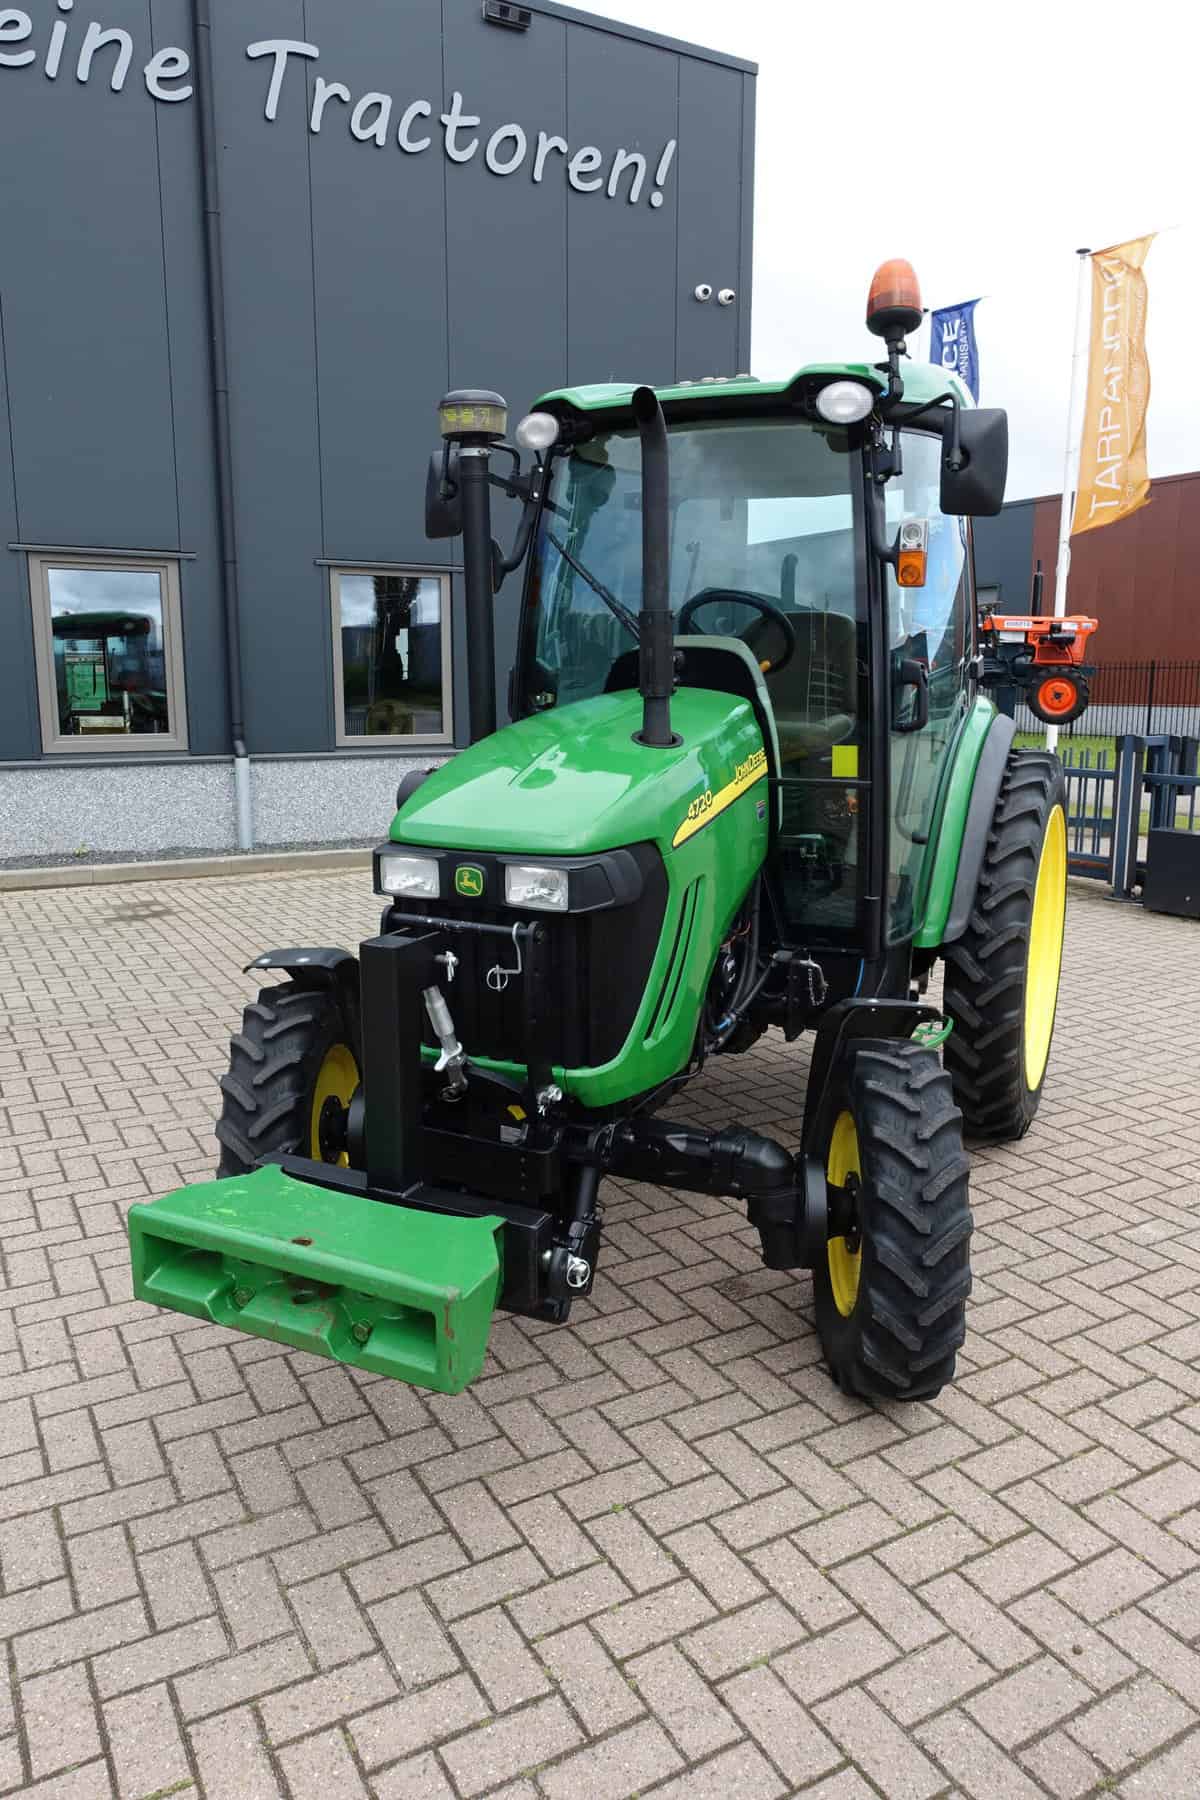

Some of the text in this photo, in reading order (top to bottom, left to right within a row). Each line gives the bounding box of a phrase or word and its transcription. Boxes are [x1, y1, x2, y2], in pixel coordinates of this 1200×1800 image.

[0, 0, 677, 209] eine Tractoren!
[687, 790, 713, 820] 4720
